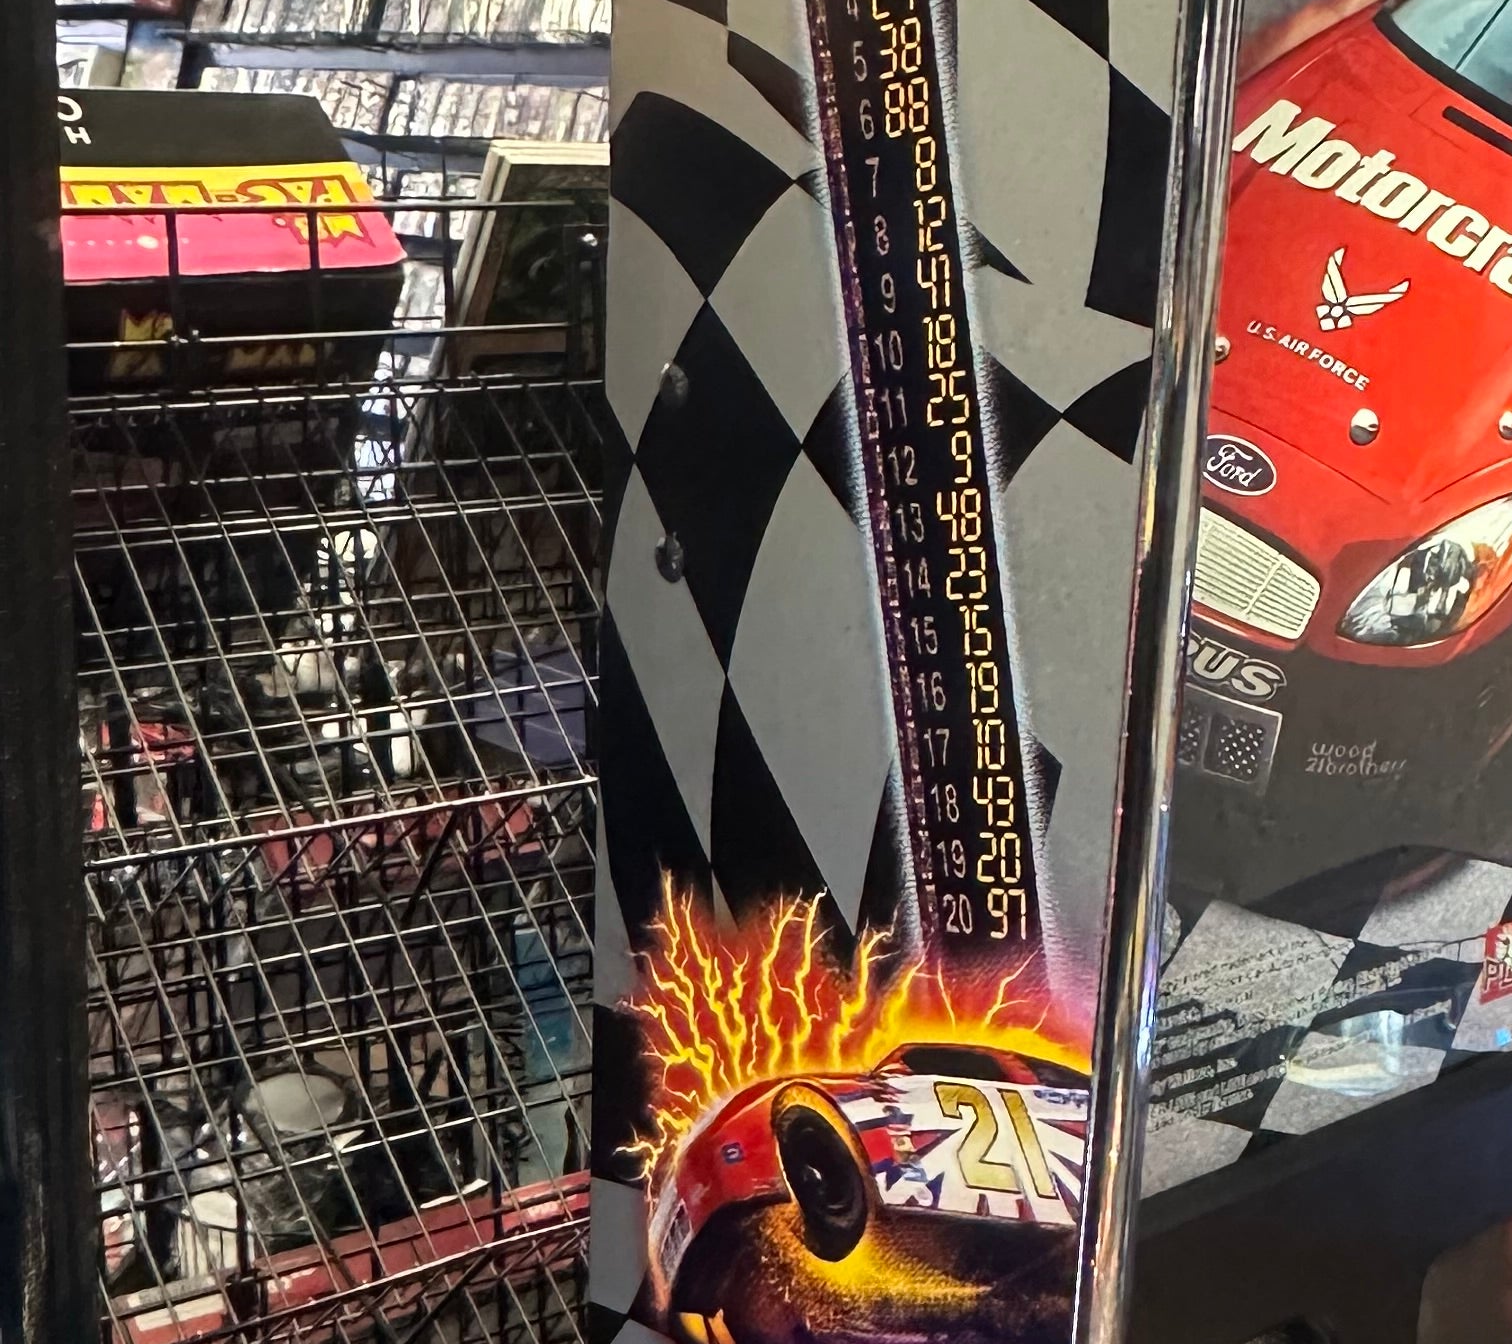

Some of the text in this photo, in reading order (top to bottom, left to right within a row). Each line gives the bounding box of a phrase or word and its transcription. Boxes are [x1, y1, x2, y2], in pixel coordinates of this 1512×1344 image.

[853, 16, 922, 82] 5 38
[859, 76, 930, 140] 6 88
[865, 135, 937, 198] 7 8
[874, 195, 947, 256] 8 12
[880, 271, 896, 314] 9
[874, 313, 956, 372] 10 18
[1278, 333, 1309, 358] AIR
[1308, 346, 1371, 393] FORCE
[879, 369, 970, 429] 11 25
[888, 430, 973, 487] 12 9
[1205, 443, 1263, 488] Ford
[895, 488, 982, 544] 13 48
[903, 545, 987, 600] 14 23
[910, 604, 992, 657] 15 15
[916, 660, 999, 714] 16 19
[1187, 631, 1287, 700] US
[923, 718, 1006, 770] 17 10
[930, 775, 1014, 828] 18 43
[936, 831, 1021, 884] 19 20
[942, 887, 1027, 941] 20 97
[933, 1081, 1058, 1200] 21
